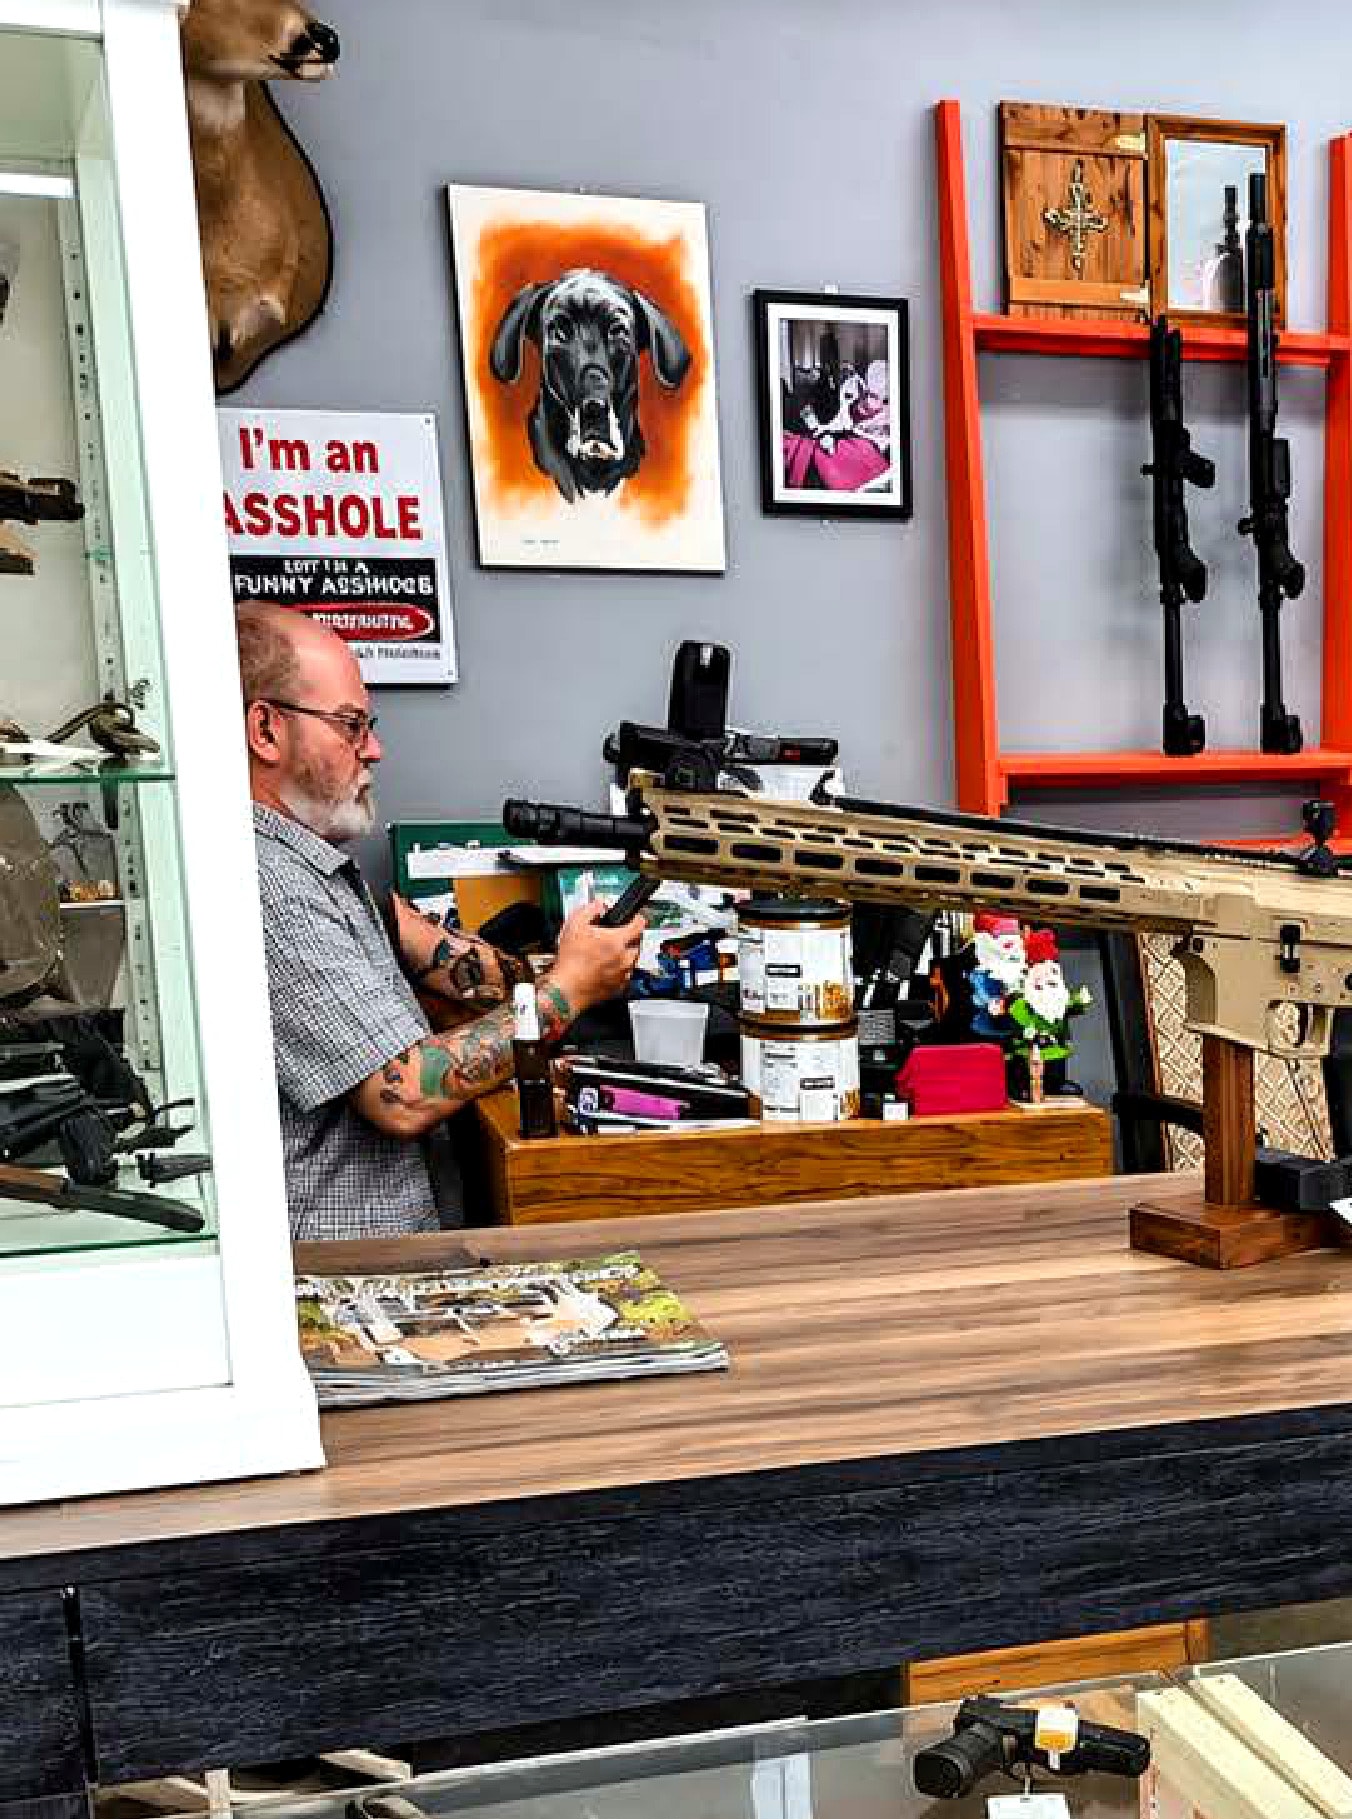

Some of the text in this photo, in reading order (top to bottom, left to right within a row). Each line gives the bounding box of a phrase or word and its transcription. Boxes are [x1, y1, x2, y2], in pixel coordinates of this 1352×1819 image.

[239, 427, 380, 474] I'm an
[223, 492, 423, 540] ASSHOLE
[235, 574, 314, 595] FUNNY
